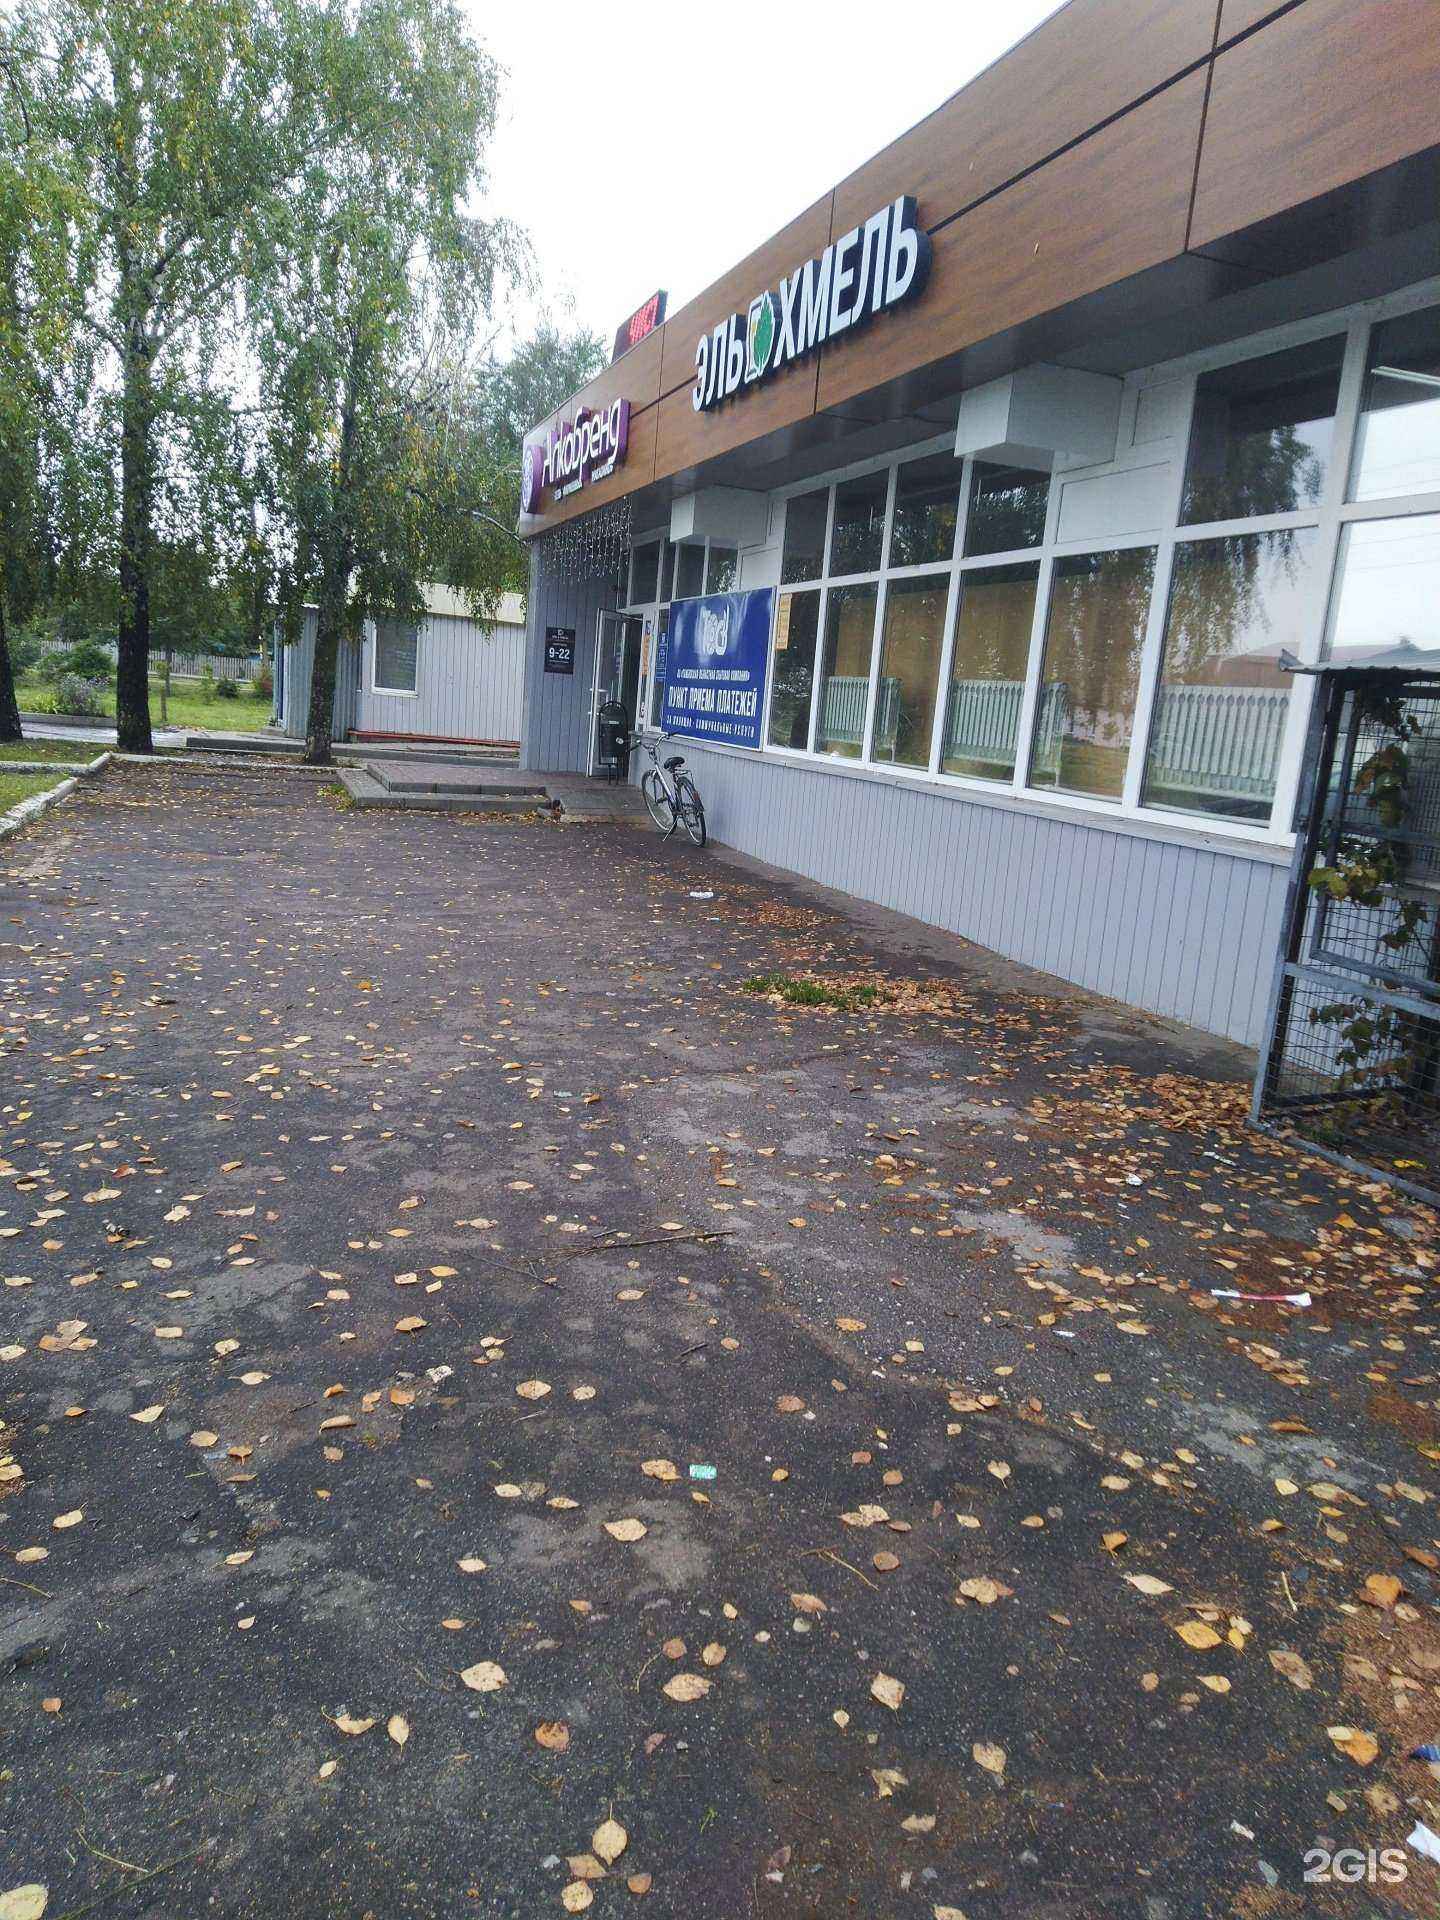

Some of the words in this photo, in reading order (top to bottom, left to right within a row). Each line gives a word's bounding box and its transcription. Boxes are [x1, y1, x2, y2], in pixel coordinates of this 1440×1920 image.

[692, 313, 743, 412] ЭЛЬ
[773, 195, 918, 368] ХМЕЛЬ
[549, 647, 570, 660] 9-22
[668, 686, 688, 709] ПУНКТ
[689, 687, 715, 712] ПРИЕМА
[716, 688, 758, 717] ПЛАТЕЖЕЙ
